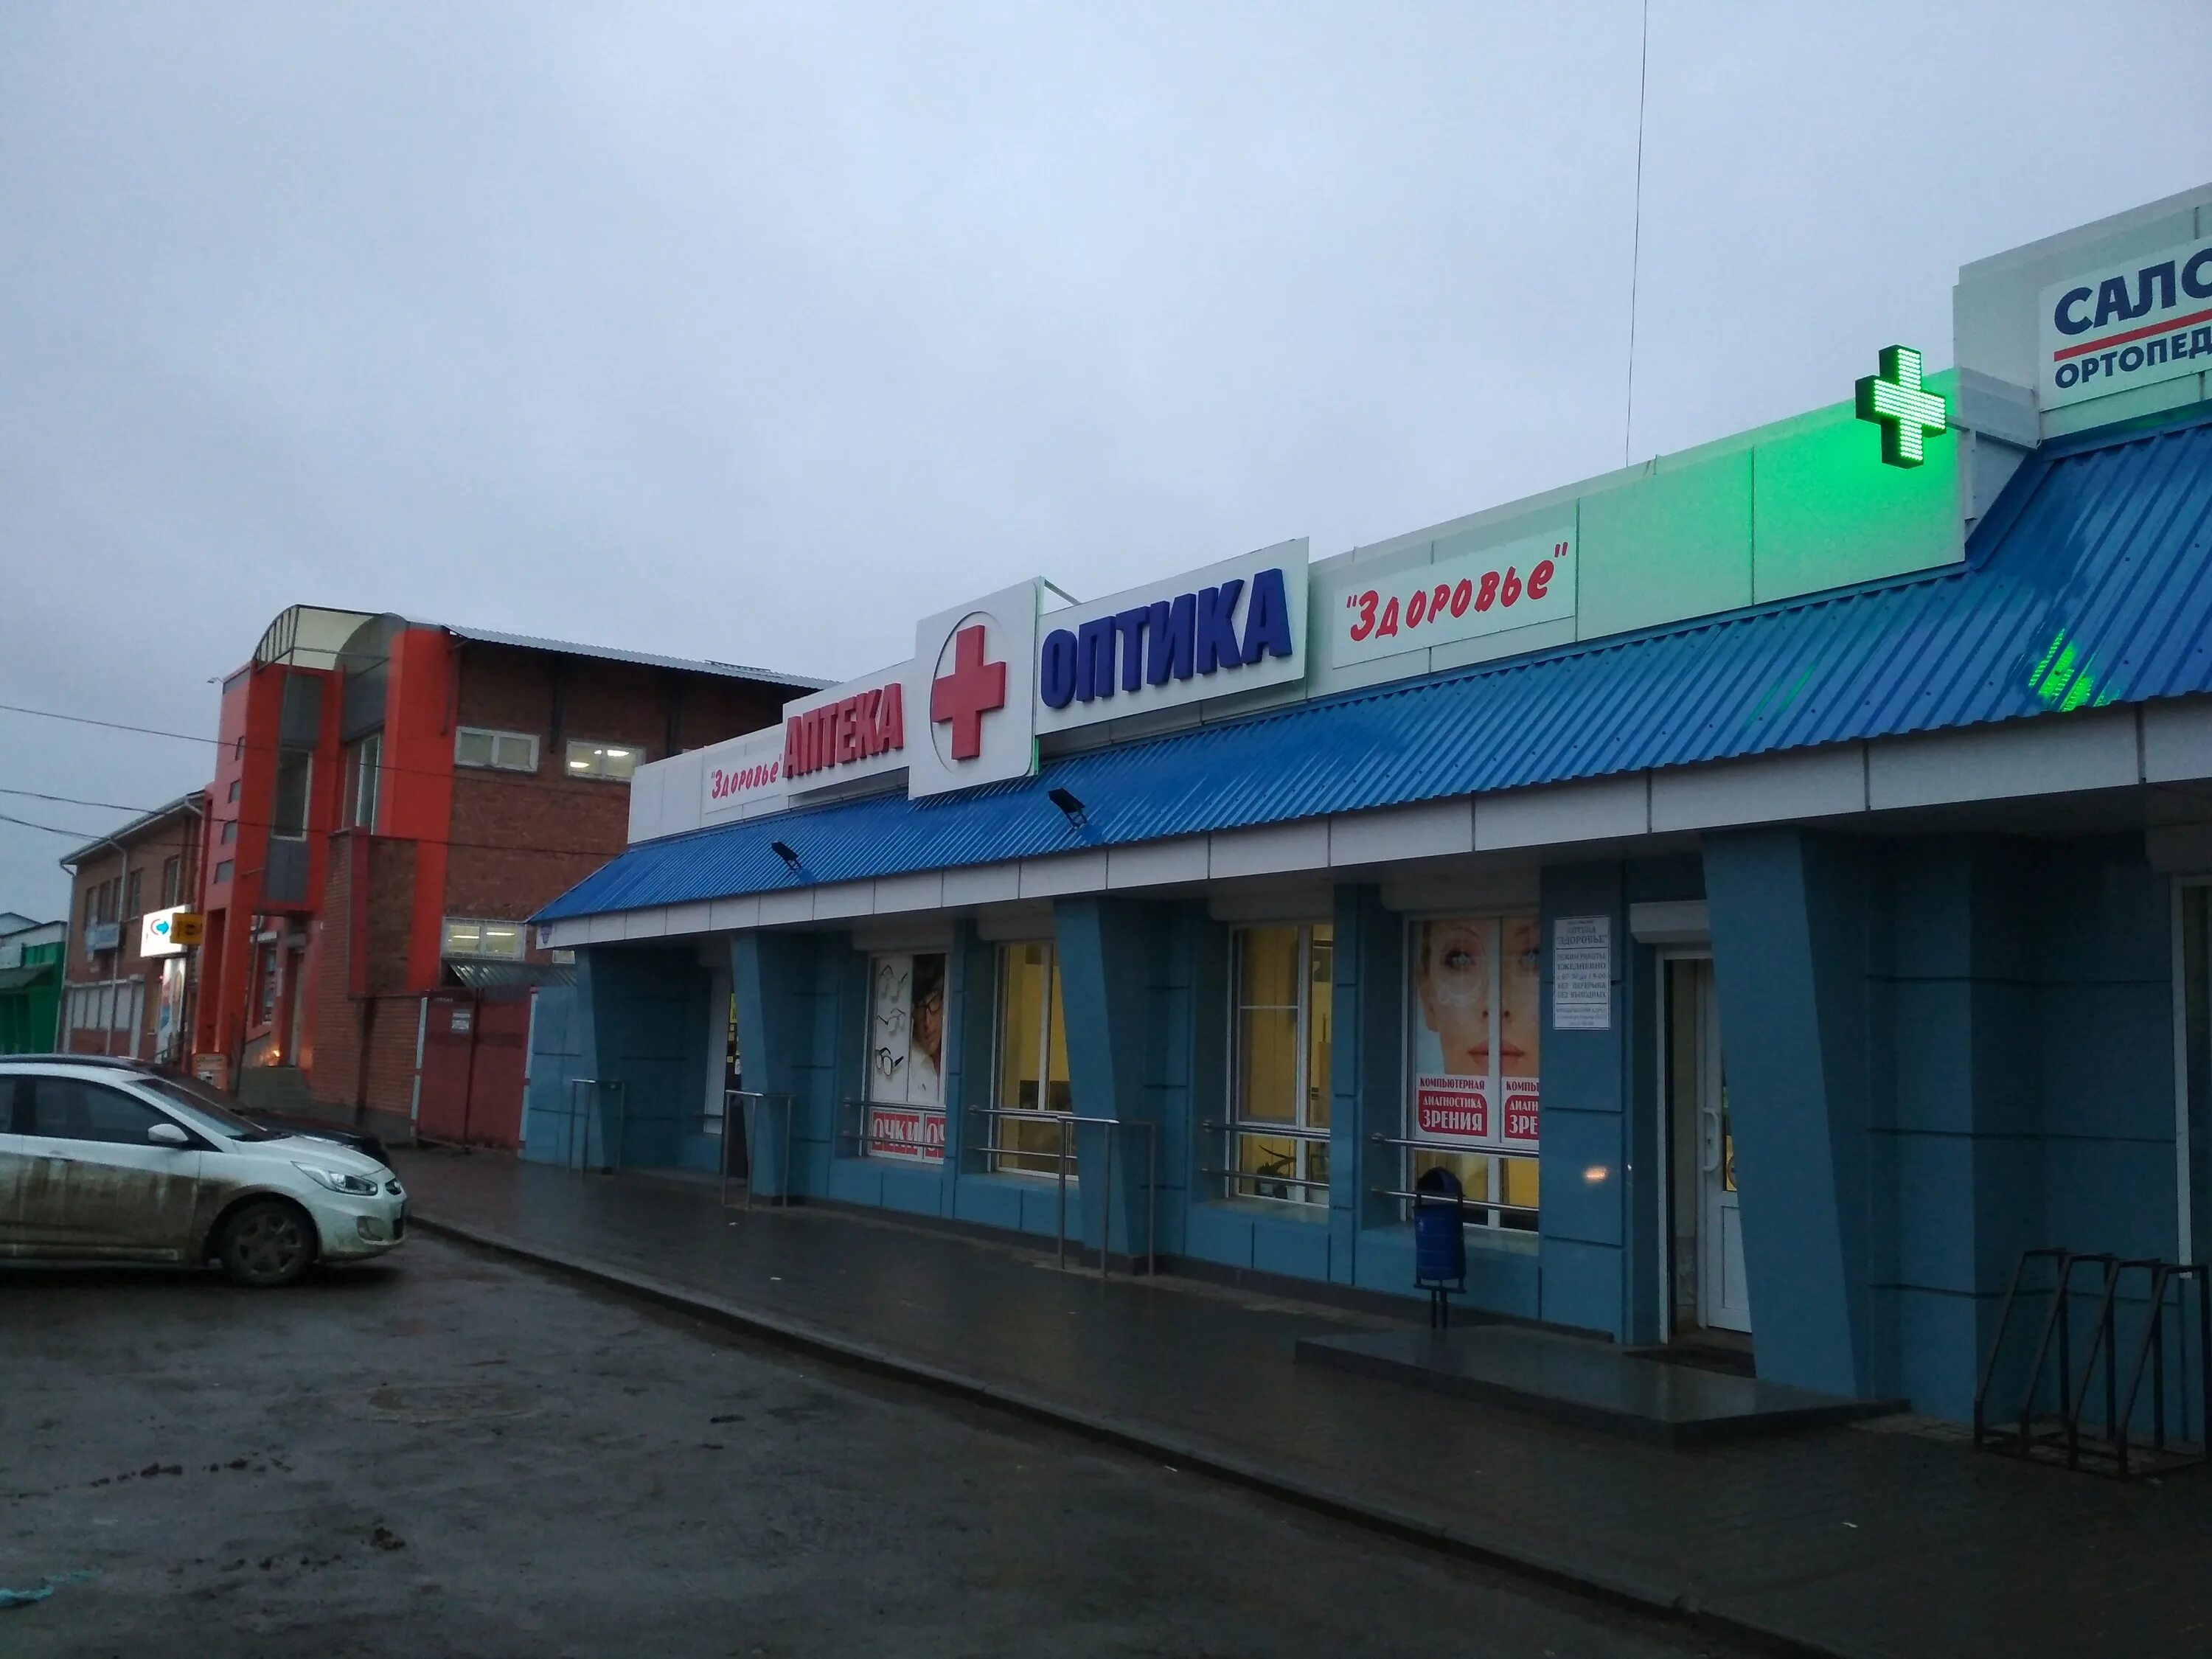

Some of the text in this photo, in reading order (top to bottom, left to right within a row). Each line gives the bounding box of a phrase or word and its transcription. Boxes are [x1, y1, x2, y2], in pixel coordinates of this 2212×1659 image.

[2054, 325, 2212, 389] ОРТОПЕД
[1040, 568, 1293, 709] ОПТИКА
[782, 683, 904, 779] АПТЕКА
[1420, 1077, 1485, 1091] КОМПЬЮТЕРНАЯ
[1506, 1081, 1539, 1092] КОМПЬ
[1422, 1096, 1482, 1109] ДИАГНОСТИКА
[872, 1118, 919, 1150] ОЧКИ
[1422, 1109, 1483, 1132] ЗРЕНИЯ
